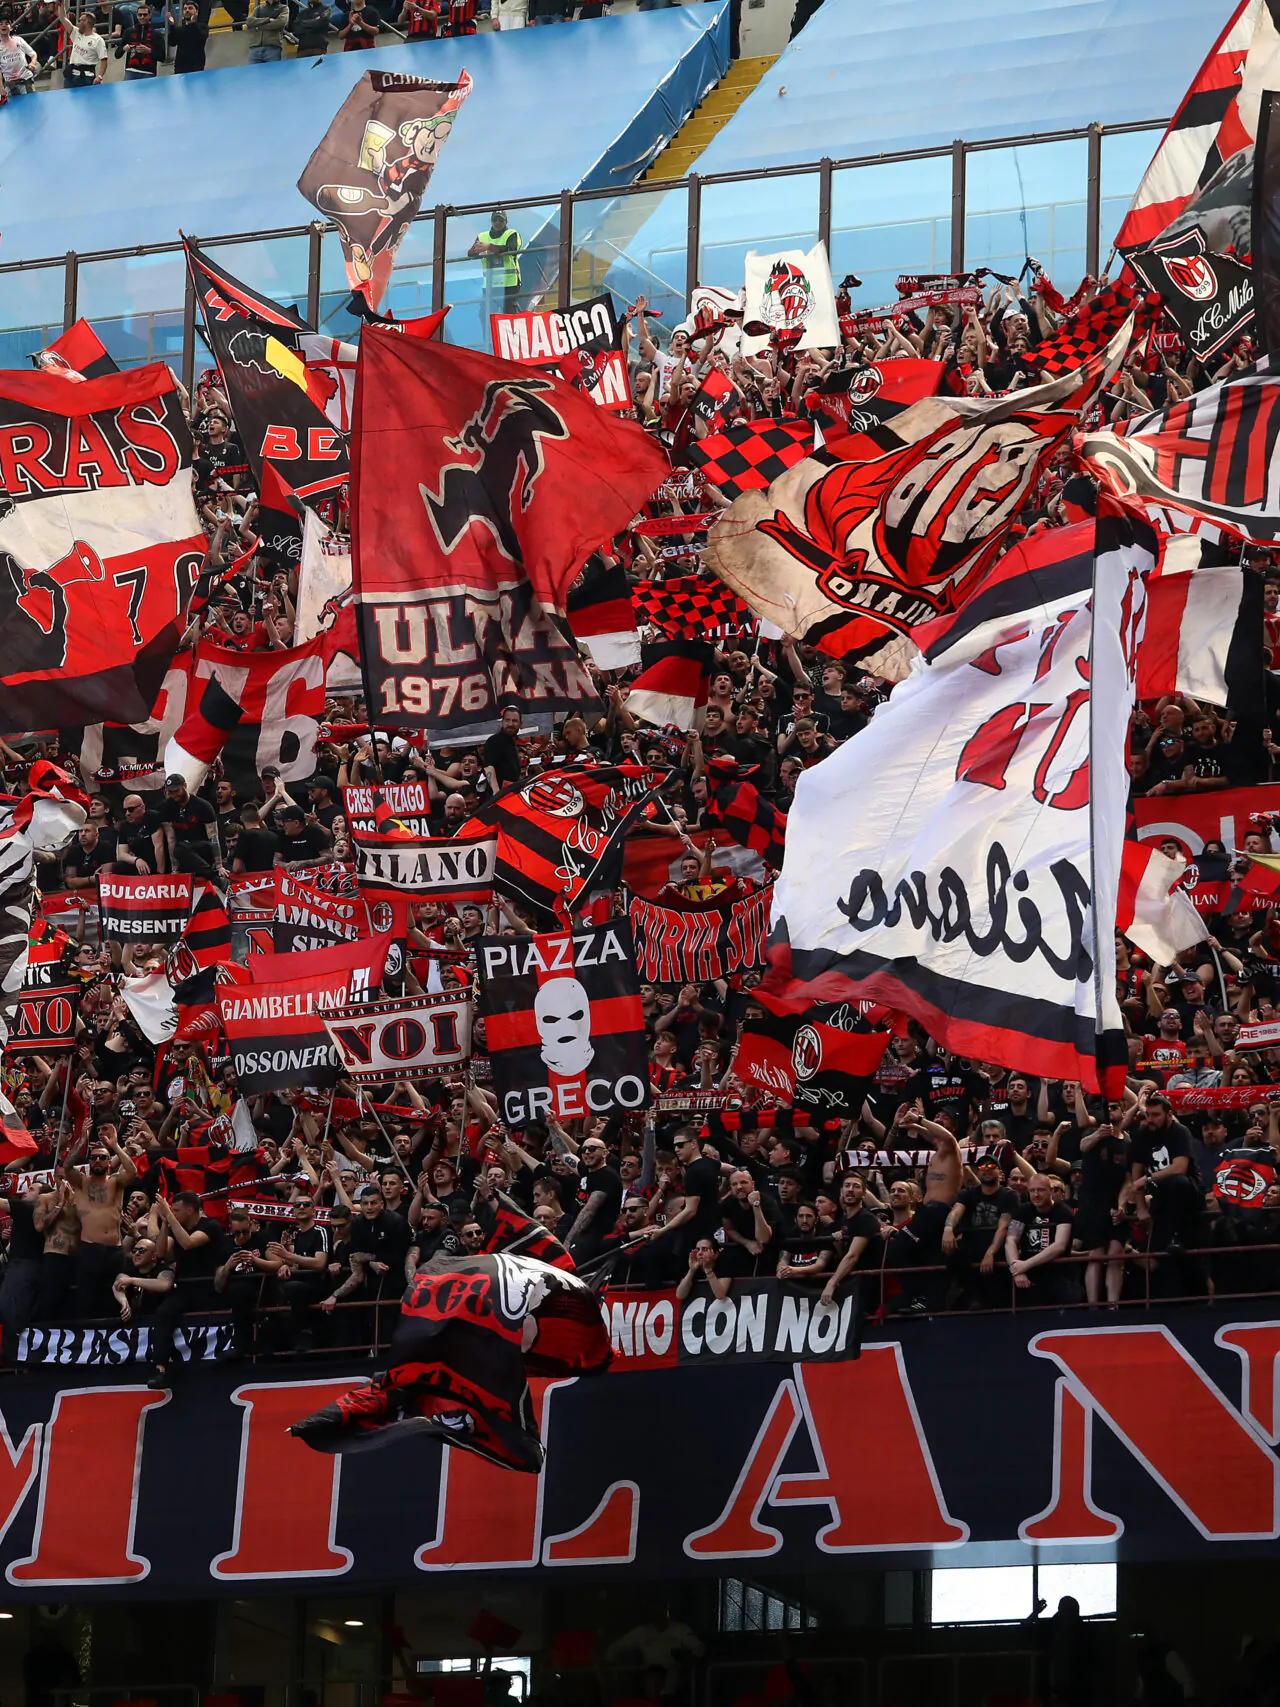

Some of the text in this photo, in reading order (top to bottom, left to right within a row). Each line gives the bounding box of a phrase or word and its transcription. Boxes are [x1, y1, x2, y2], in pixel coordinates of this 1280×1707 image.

[1226, 278, 1254, 319] Mila
[497, 303, 614, 361] MAGICO
[260, 425, 351, 461] BE
[379, 673, 489, 717] 1976
[346, 785, 427, 814] CRESENZAGO
[561, 793, 582, 817] 1899
[99, 883, 189, 900] BULGARIA
[281, 877, 355, 919] UNICO
[101, 917, 188, 935] PRESENTE
[272, 903, 360, 942] AMORE
[629, 896, 724, 984] CURVA
[483, 929, 629, 980] PIAZZA
[220, 985, 348, 1021] GIAMBELLINO
[319, 992, 468, 1019] CURVA SUD MILANO
[331, 1011, 461, 1066] NOI
[502, 1074, 645, 1125] GRECO
[682, 1293, 768, 1356] CON
[774, 1294, 853, 1353] NOI
